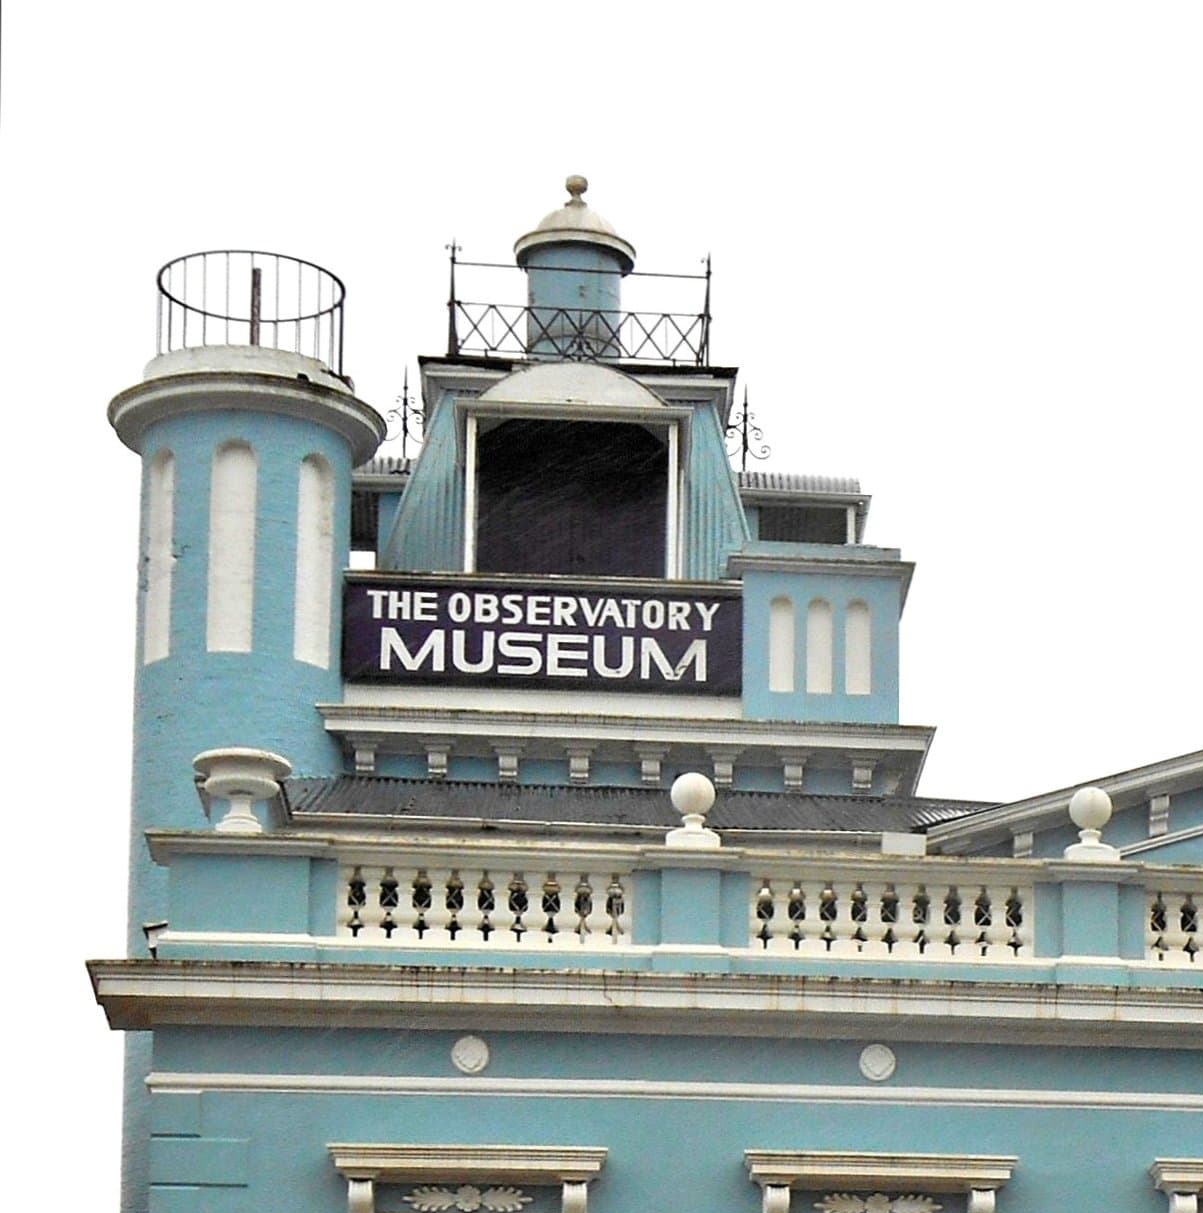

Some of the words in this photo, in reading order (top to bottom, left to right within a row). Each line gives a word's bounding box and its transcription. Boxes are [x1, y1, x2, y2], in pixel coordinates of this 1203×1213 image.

[367, 589, 438, 621] THE
[448, 592, 720, 631] OBSERVATORY
[380, 627, 708, 682] MUSEUM
